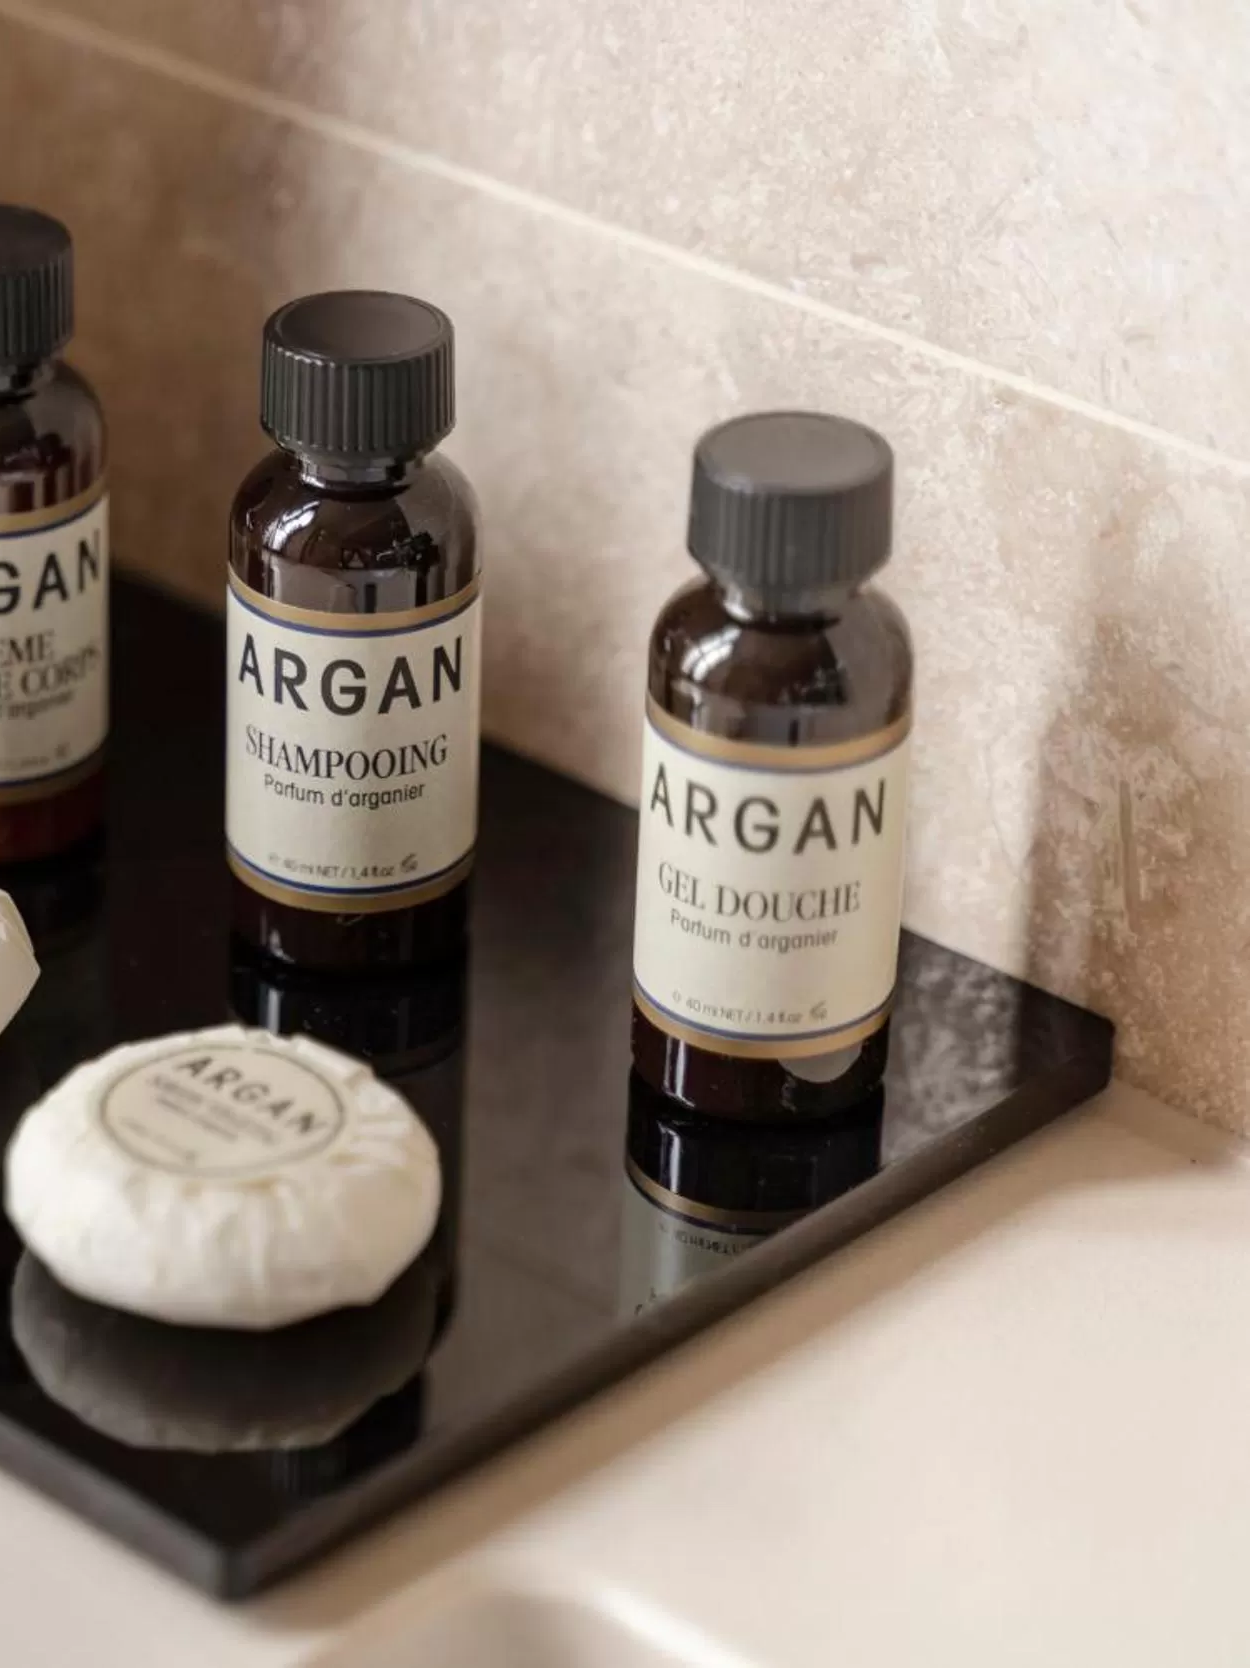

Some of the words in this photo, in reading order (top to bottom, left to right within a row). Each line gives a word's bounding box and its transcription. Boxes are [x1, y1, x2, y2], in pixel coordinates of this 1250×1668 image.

[238, 632, 463, 716] ARGAN
[245, 724, 449, 780] SHAMPOOING
[264, 773, 325, 806] Parfum
[330, 783, 426, 811] d'arganier
[649, 761, 887, 856] ARGAN
[658, 861, 706, 910] GEL
[715, 880, 862, 923] DOUCHE
[670, 908, 731, 947] Parfum
[738, 928, 839, 953] d'arganier
[174, 1055, 328, 1134] ARGAN
